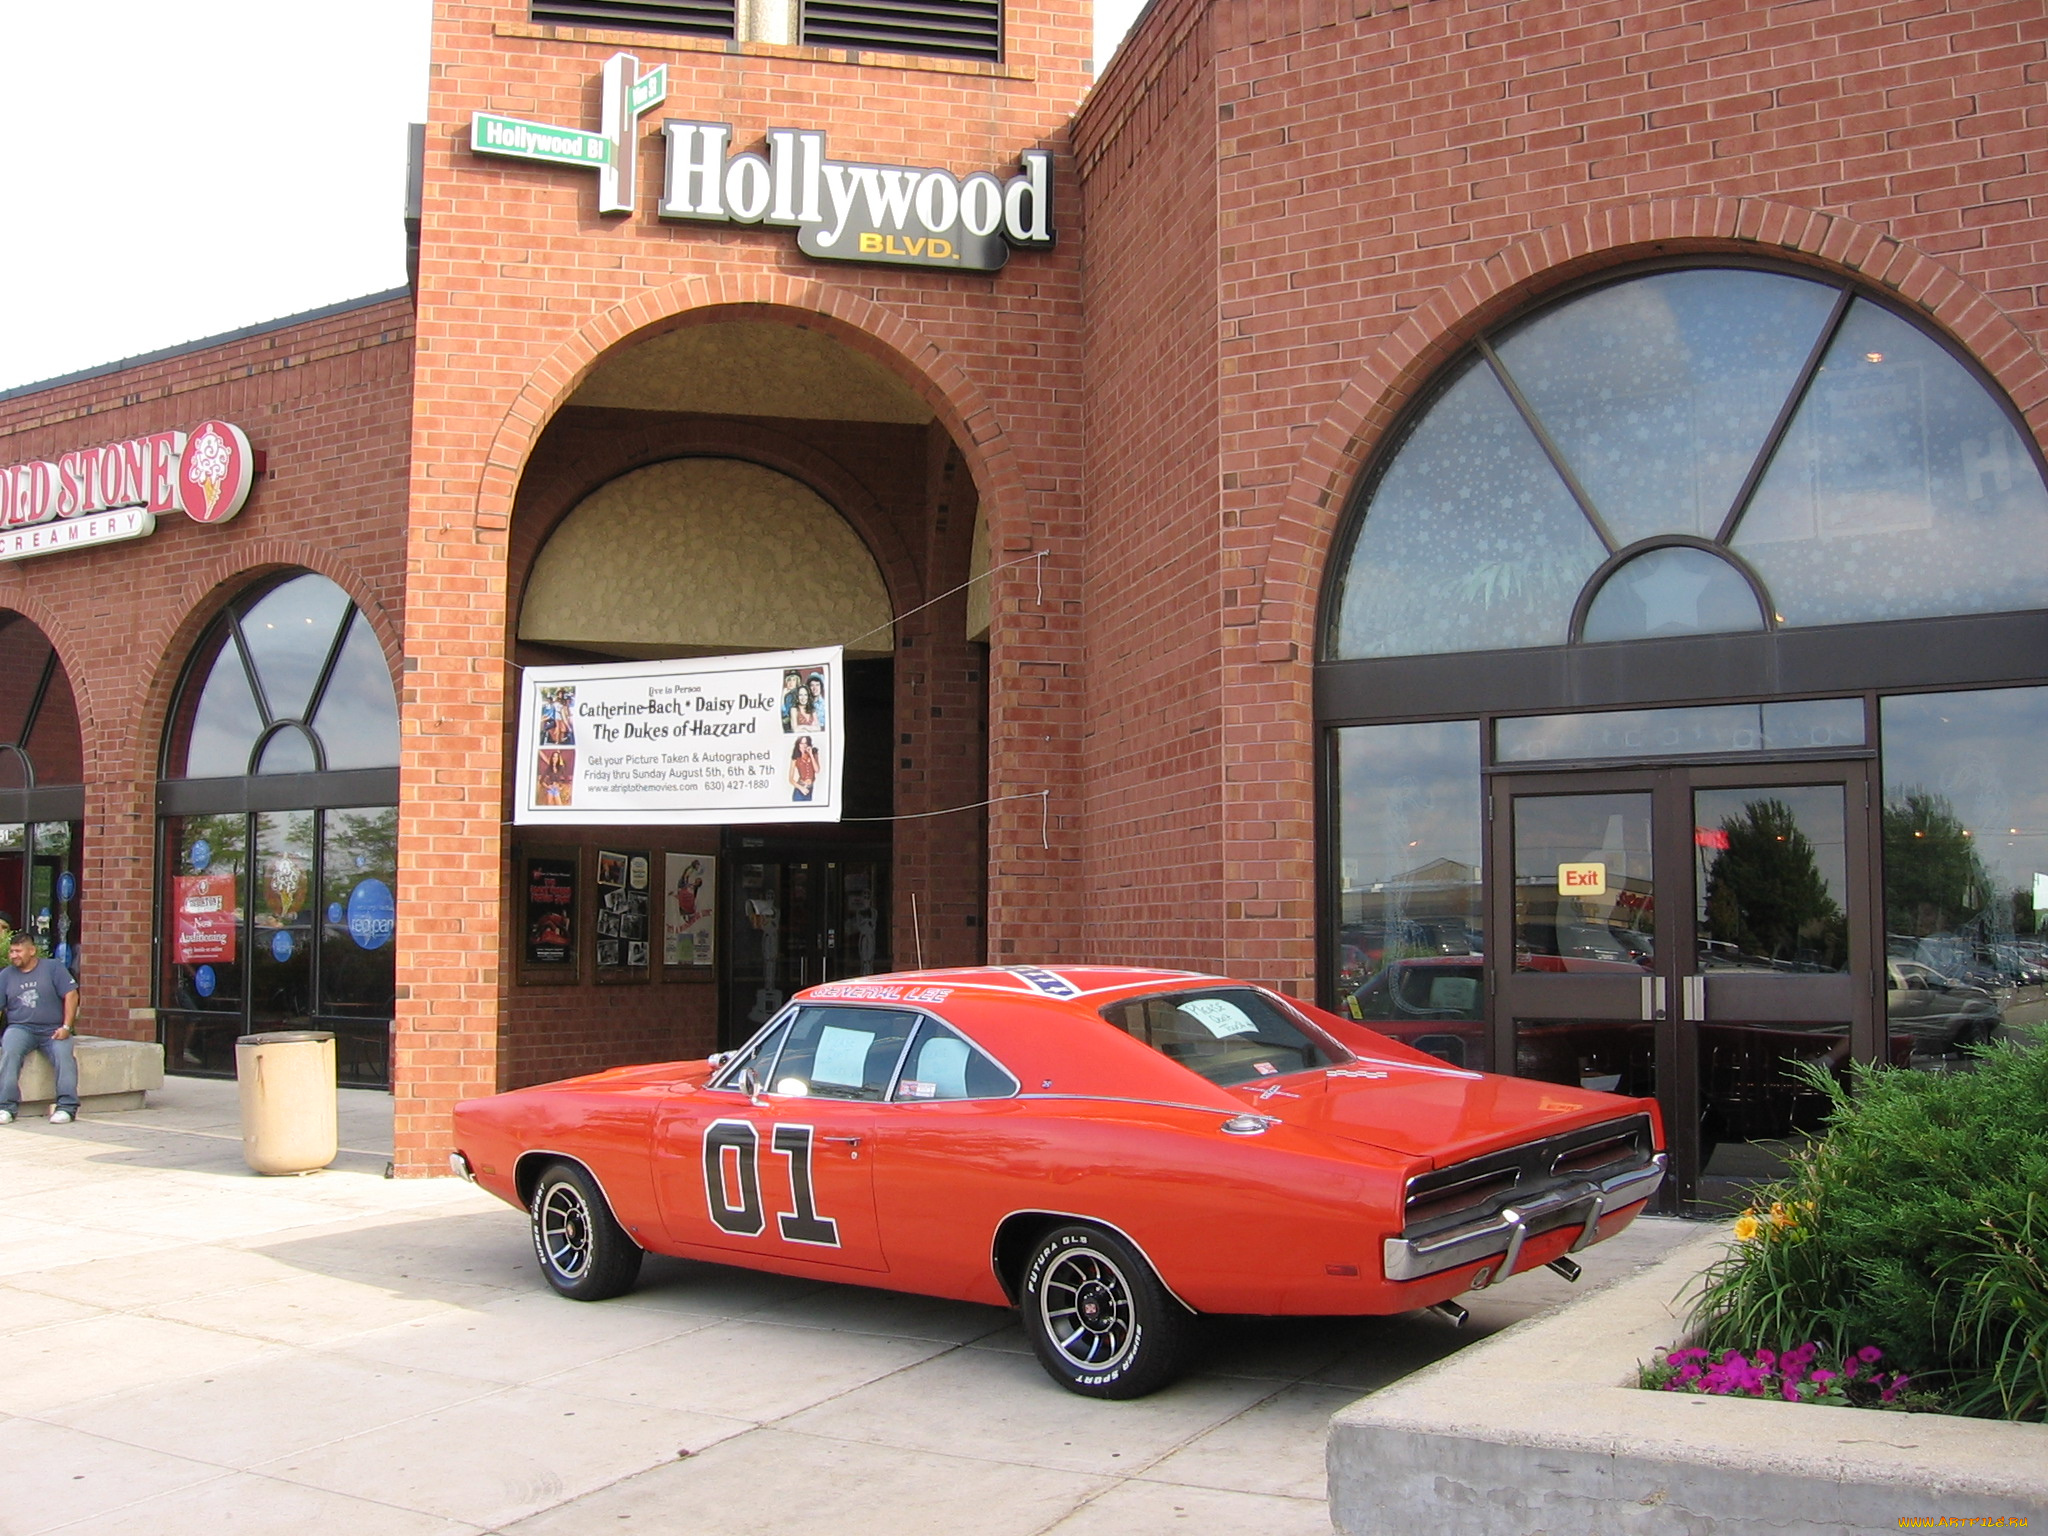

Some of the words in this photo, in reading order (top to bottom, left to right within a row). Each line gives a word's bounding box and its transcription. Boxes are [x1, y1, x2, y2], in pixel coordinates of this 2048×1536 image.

[486, 120, 584, 157] Hollywood
[664, 122, 1052, 248] Hollywood
[858, 231, 961, 260] BLVD.
[57, 431, 176, 519] STONE
[648, 686, 664, 697] Live
[674, 684, 702, 694] Person
[579, 701, 644, 720] Catherine
[646, 698, 685, 717] Bach
[695, 696, 735, 715] Daisy
[738, 693, 775, 711] Duke
[592, 723, 619, 743] The
[624, 721, 670, 741] Dukes
[673, 720, 690, 737] of
[690, 717, 756, 738] Hazzard
[588, 755, 603, 766] Get
[604, 756, 624, 768] your
[625, 754, 659, 765] Picture
[661, 753, 690, 764] Taken
[691, 752, 700, 763] &
[701, 749, 771, 764] Autographed
[583, 769, 611, 782] Friday
[612, 769, 631, 780] thru
[632, 768, 667, 781] Sunday
[668, 767, 704, 781] August
[705, 766, 725, 779] 5th,
[727, 766, 745, 777] 6th
[747, 765, 757, 776] &
[758, 764, 775, 776] 7th
[1566, 870, 1599, 886] Exit
[810, 985, 904, 1000] GENERAL
[903, 986, 955, 1004] LEE
[704, 1118, 842, 1249] 01
[1028, 1242, 1059, 1294] FUTURA
[1121, 1323, 1144, 1372] SUPER
[1074, 1370, 1120, 1385] SPORT
